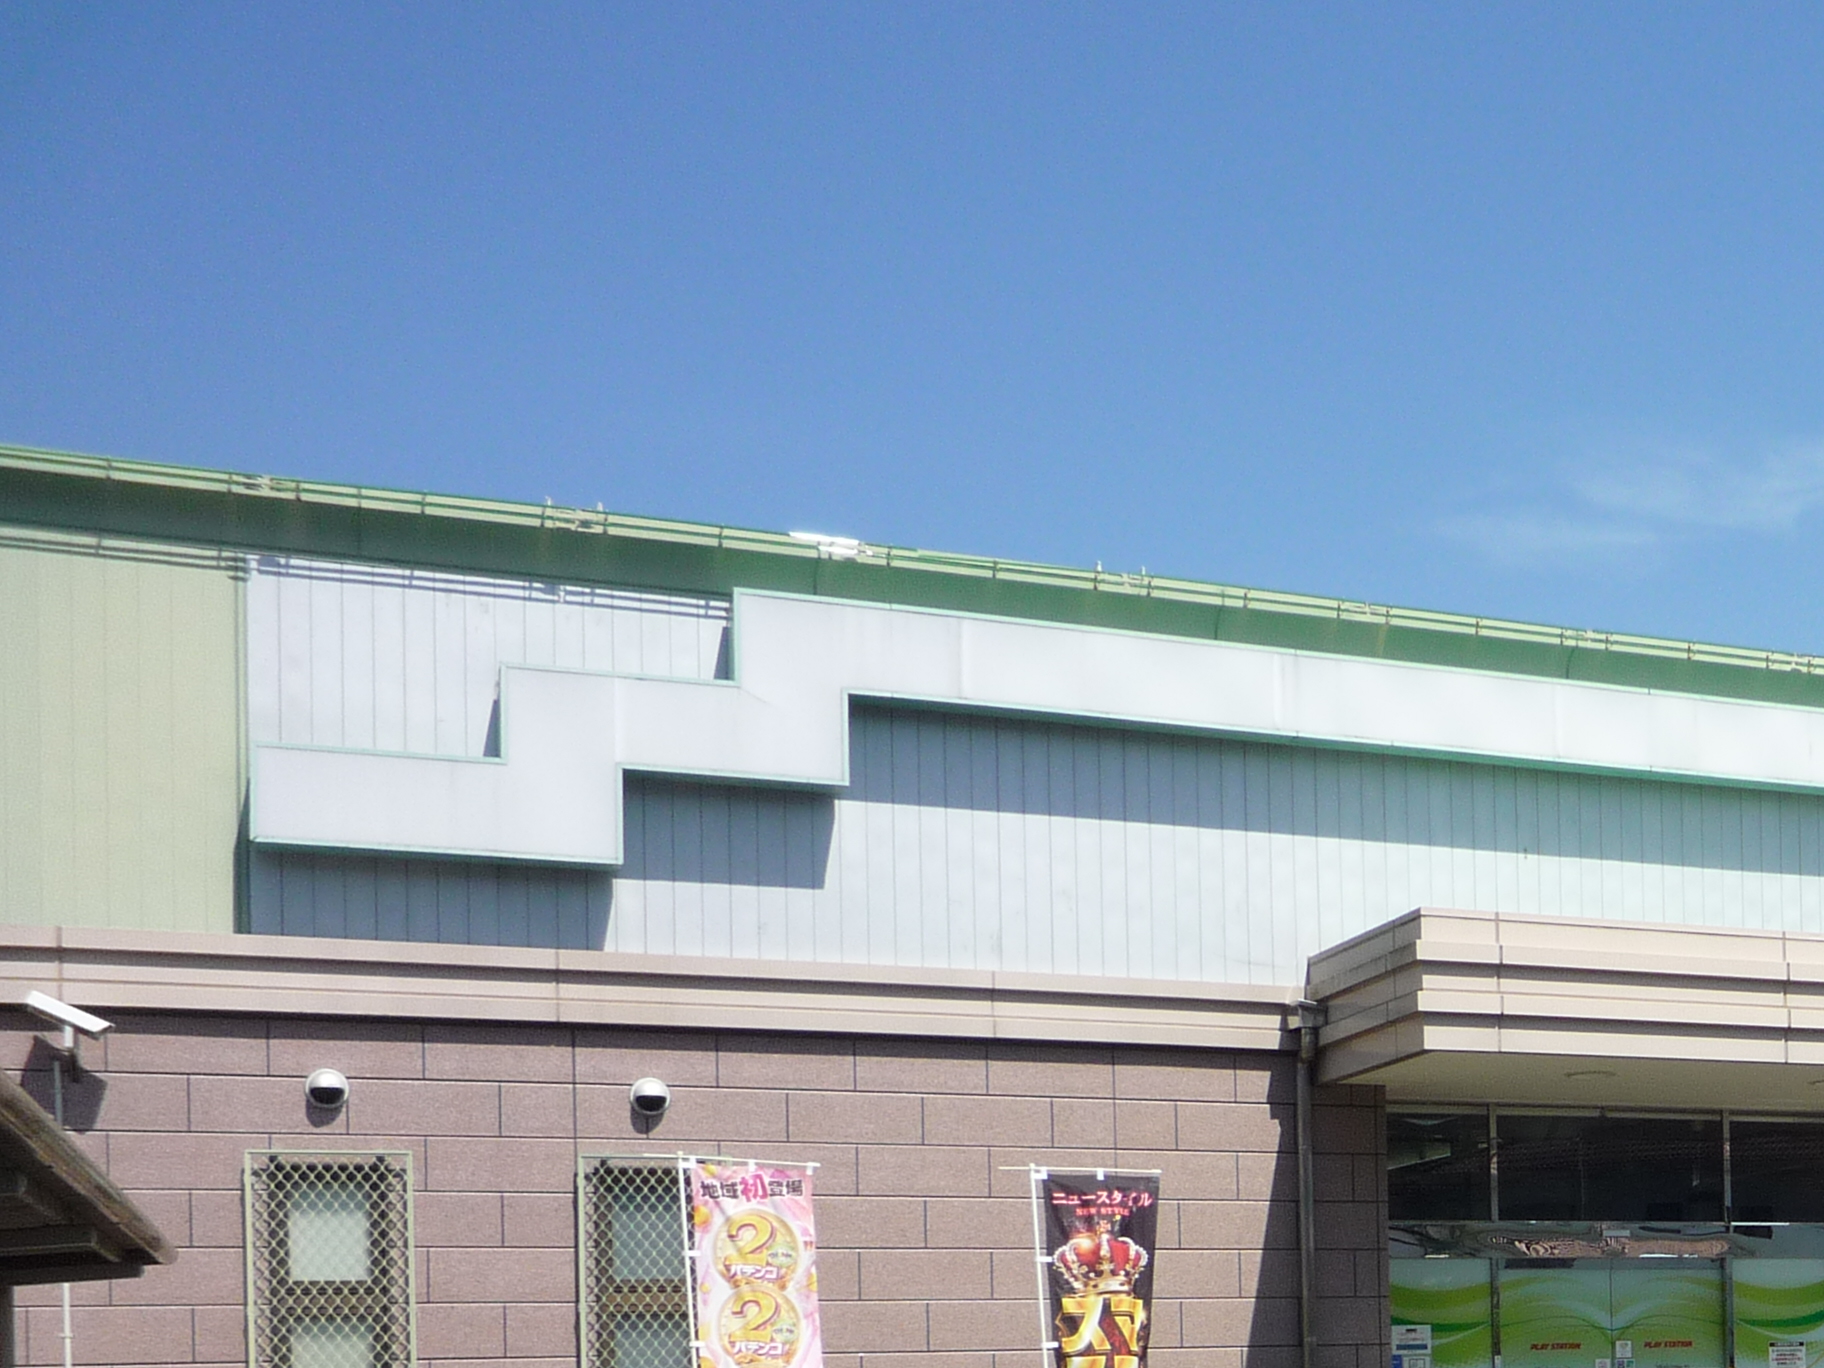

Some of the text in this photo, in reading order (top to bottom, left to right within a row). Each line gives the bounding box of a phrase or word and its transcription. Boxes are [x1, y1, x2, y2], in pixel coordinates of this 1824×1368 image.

[700, 1172, 804, 1202] 地域初登場
[1051, 1190, 1152, 1207] ニュースタイル
[723, 1213, 777, 1267] 2
[726, 1263, 780, 1280] パチンコ
[728, 1289, 781, 1343] 2
[731, 1340, 784, 1357] パチンコ
[1530, 1343, 1550, 1351] PLAY
